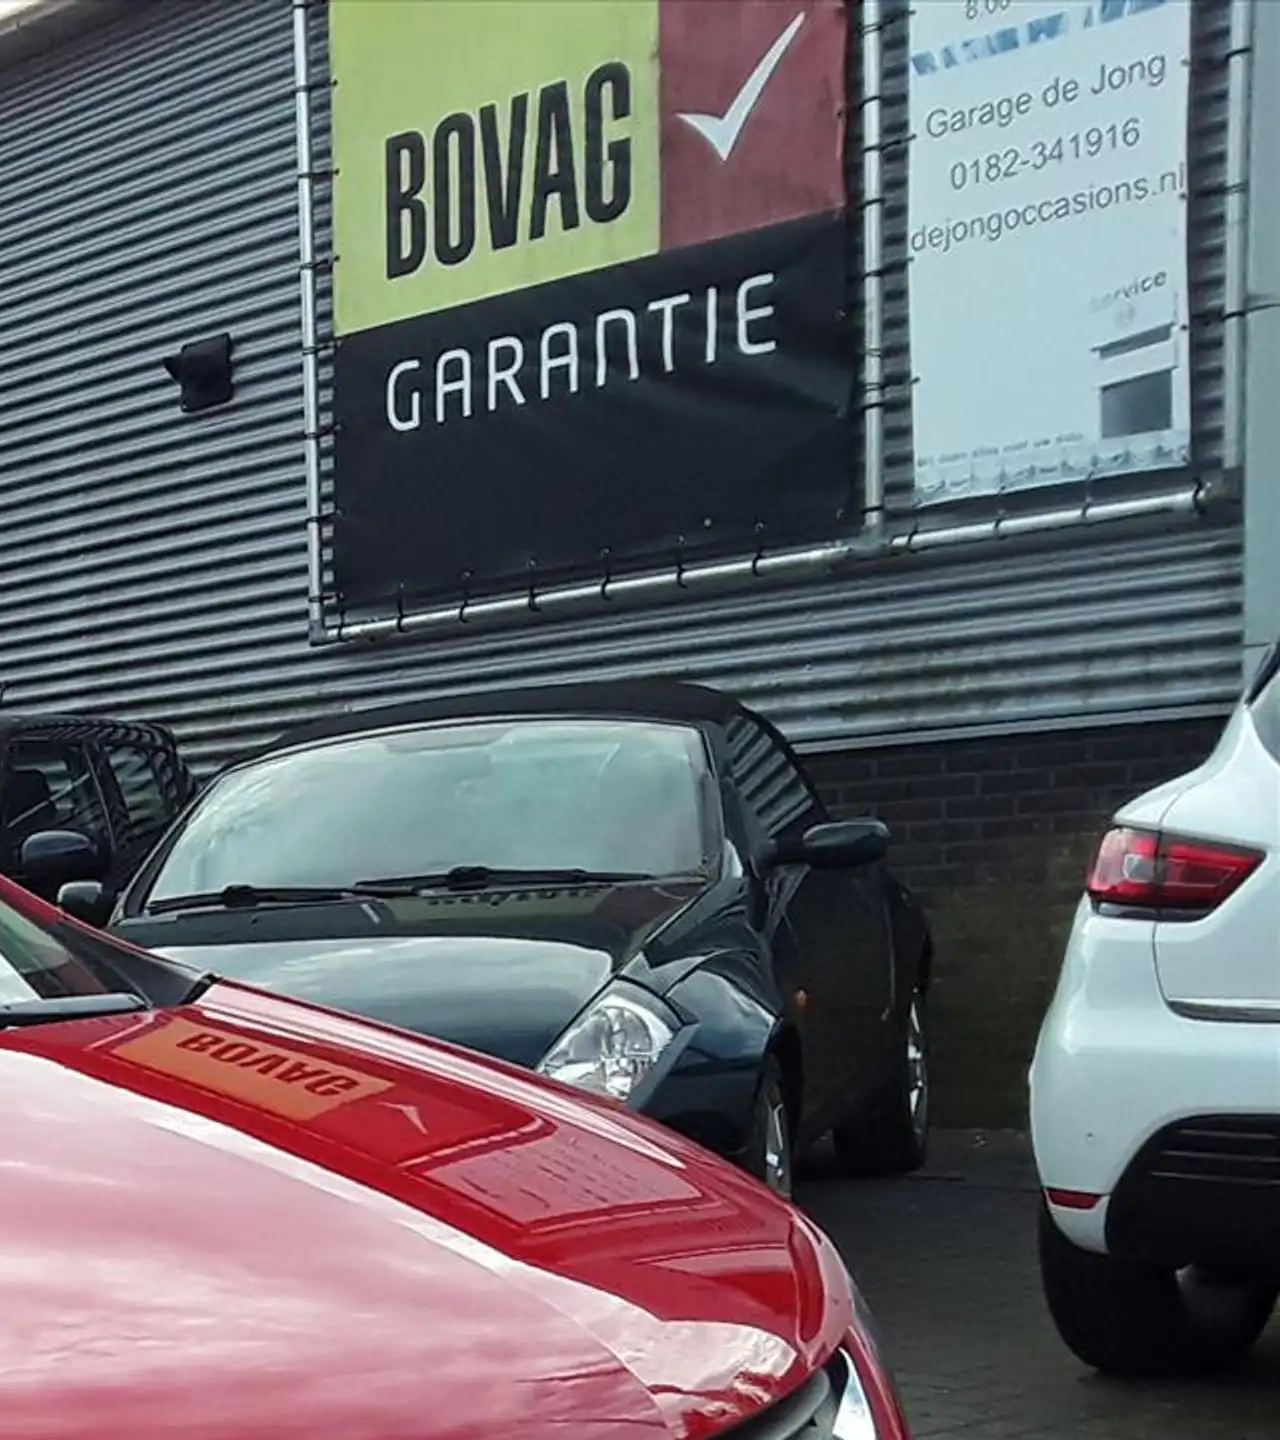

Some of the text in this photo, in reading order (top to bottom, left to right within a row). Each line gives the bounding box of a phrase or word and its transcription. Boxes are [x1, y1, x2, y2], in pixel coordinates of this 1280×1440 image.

[926, 54, 1166, 138] Garage de Jong
[386, 62, 631, 279] BOVAG
[950, 117, 1141, 190] 0182-341916
[911, 162, 1185, 252] dejongoccasions.nl
[1089, 271, 1167, 313] rvice
[386, 273, 777, 432] GARANTIE
